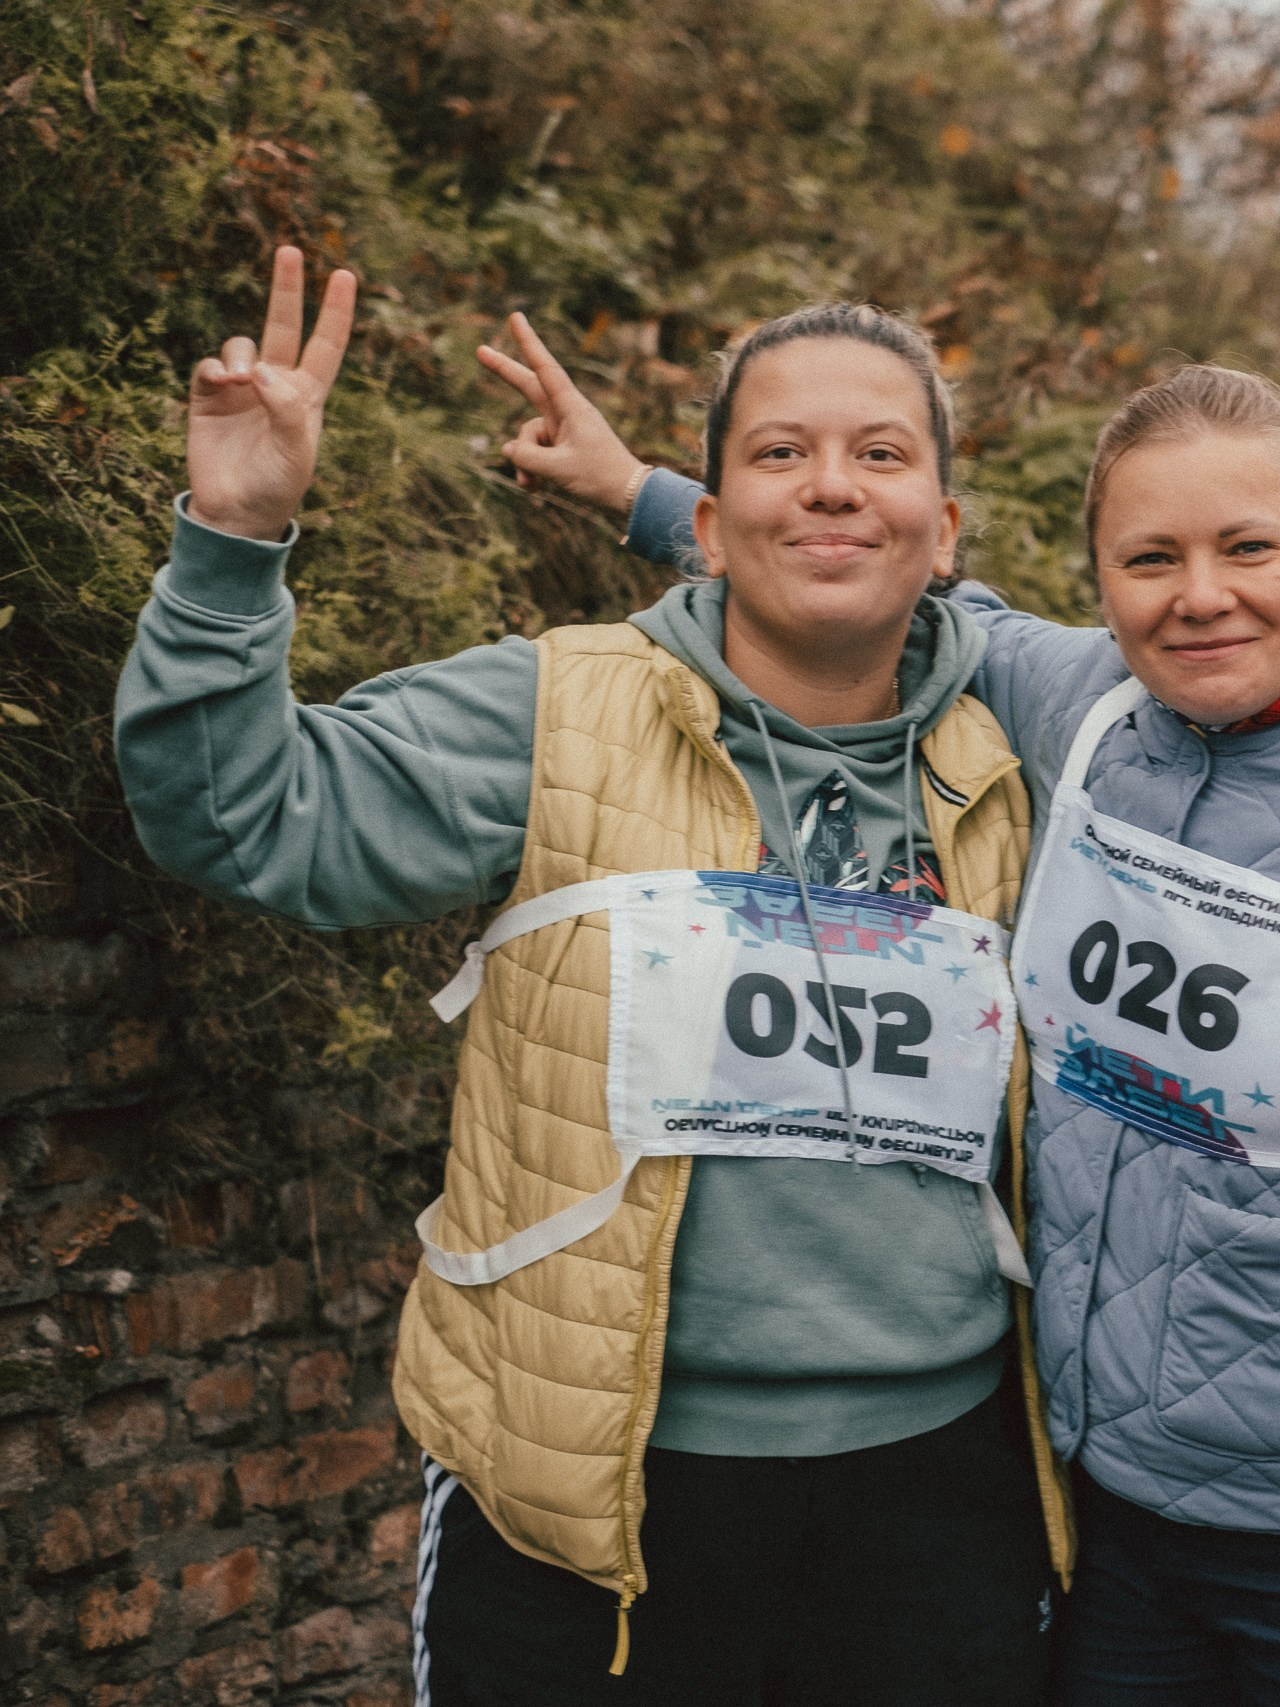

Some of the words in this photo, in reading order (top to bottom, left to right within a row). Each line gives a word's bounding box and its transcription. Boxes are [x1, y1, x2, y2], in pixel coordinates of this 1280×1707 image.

[1132, 855, 1221, 896] СЕМЕЙНЫЙ
[1069, 920, 1251, 1052] 026
[1065, 1022, 1225, 1115] ЙЕТИ
